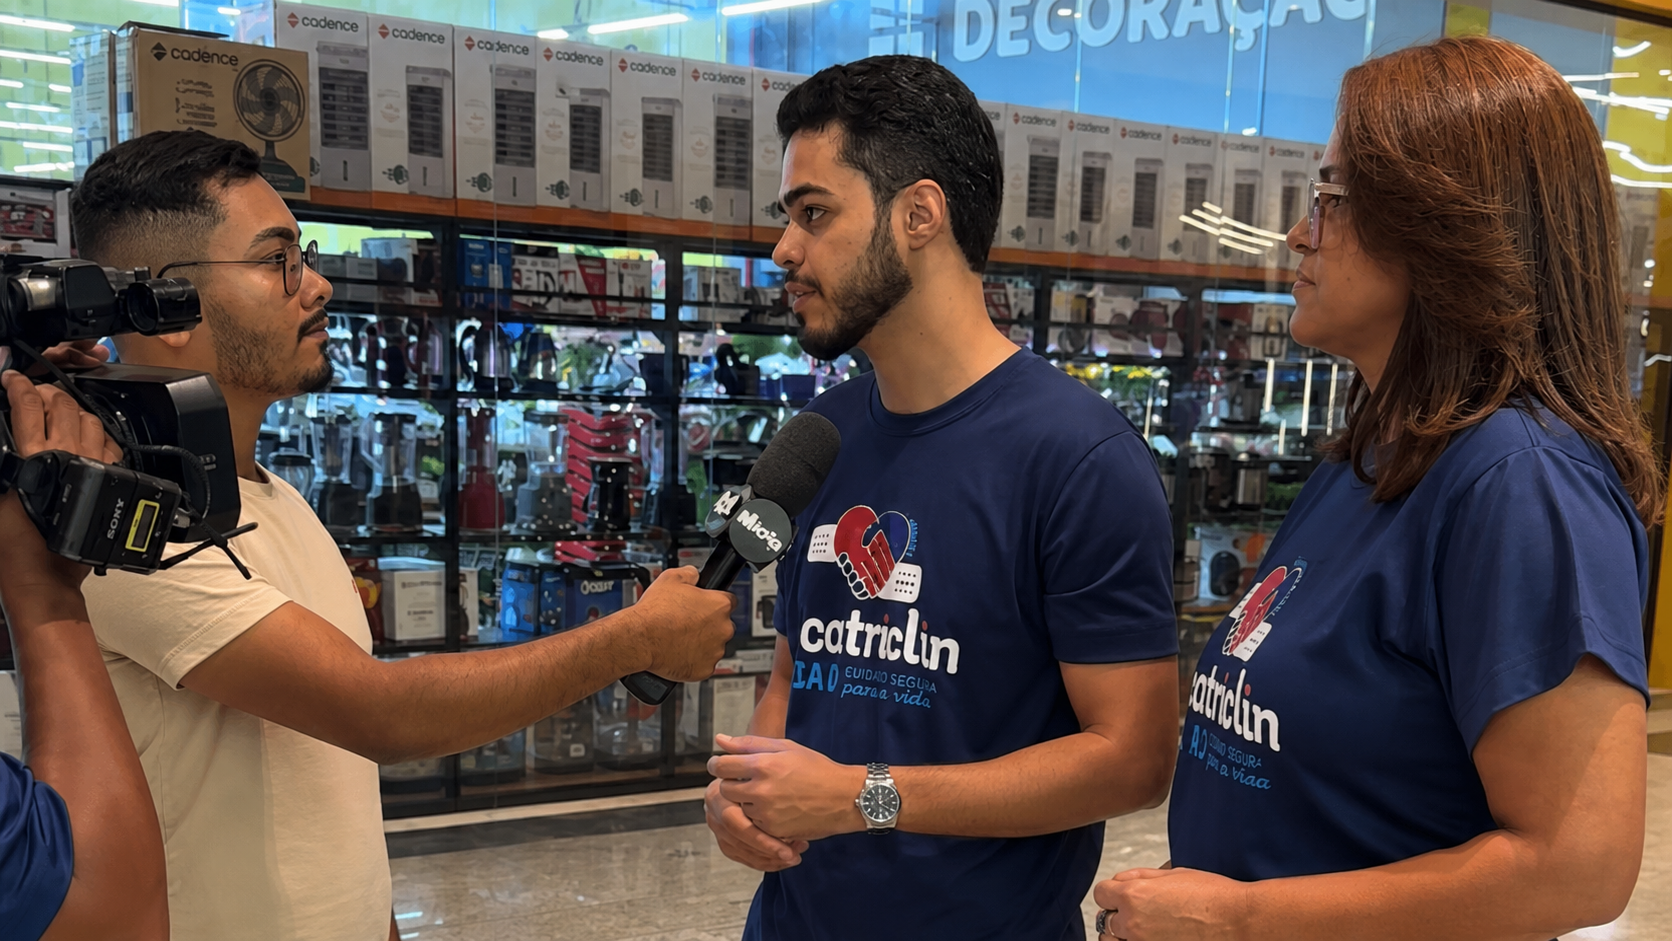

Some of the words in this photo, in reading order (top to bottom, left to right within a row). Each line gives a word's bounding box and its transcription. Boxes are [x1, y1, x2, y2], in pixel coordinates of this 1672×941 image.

[302, 16, 359, 32] cadence
[392, 26, 445, 44] cadence
[477, 39, 529, 56] cadence
[171, 47, 239, 67] cadence
[555, 50, 604, 66] cadence
[630, 60, 676, 76] cadence
[702, 70, 746, 86] cadence
[1021, 114, 1057, 128] cadence
[1076, 121, 1110, 134] cadence
[1128, 128, 1162, 141] cadence
[1180, 134, 1212, 147] cadence
[107, 498, 124, 540] SONY
[800, 608, 960, 675] catriclin
[893, 689, 931, 708] vida
